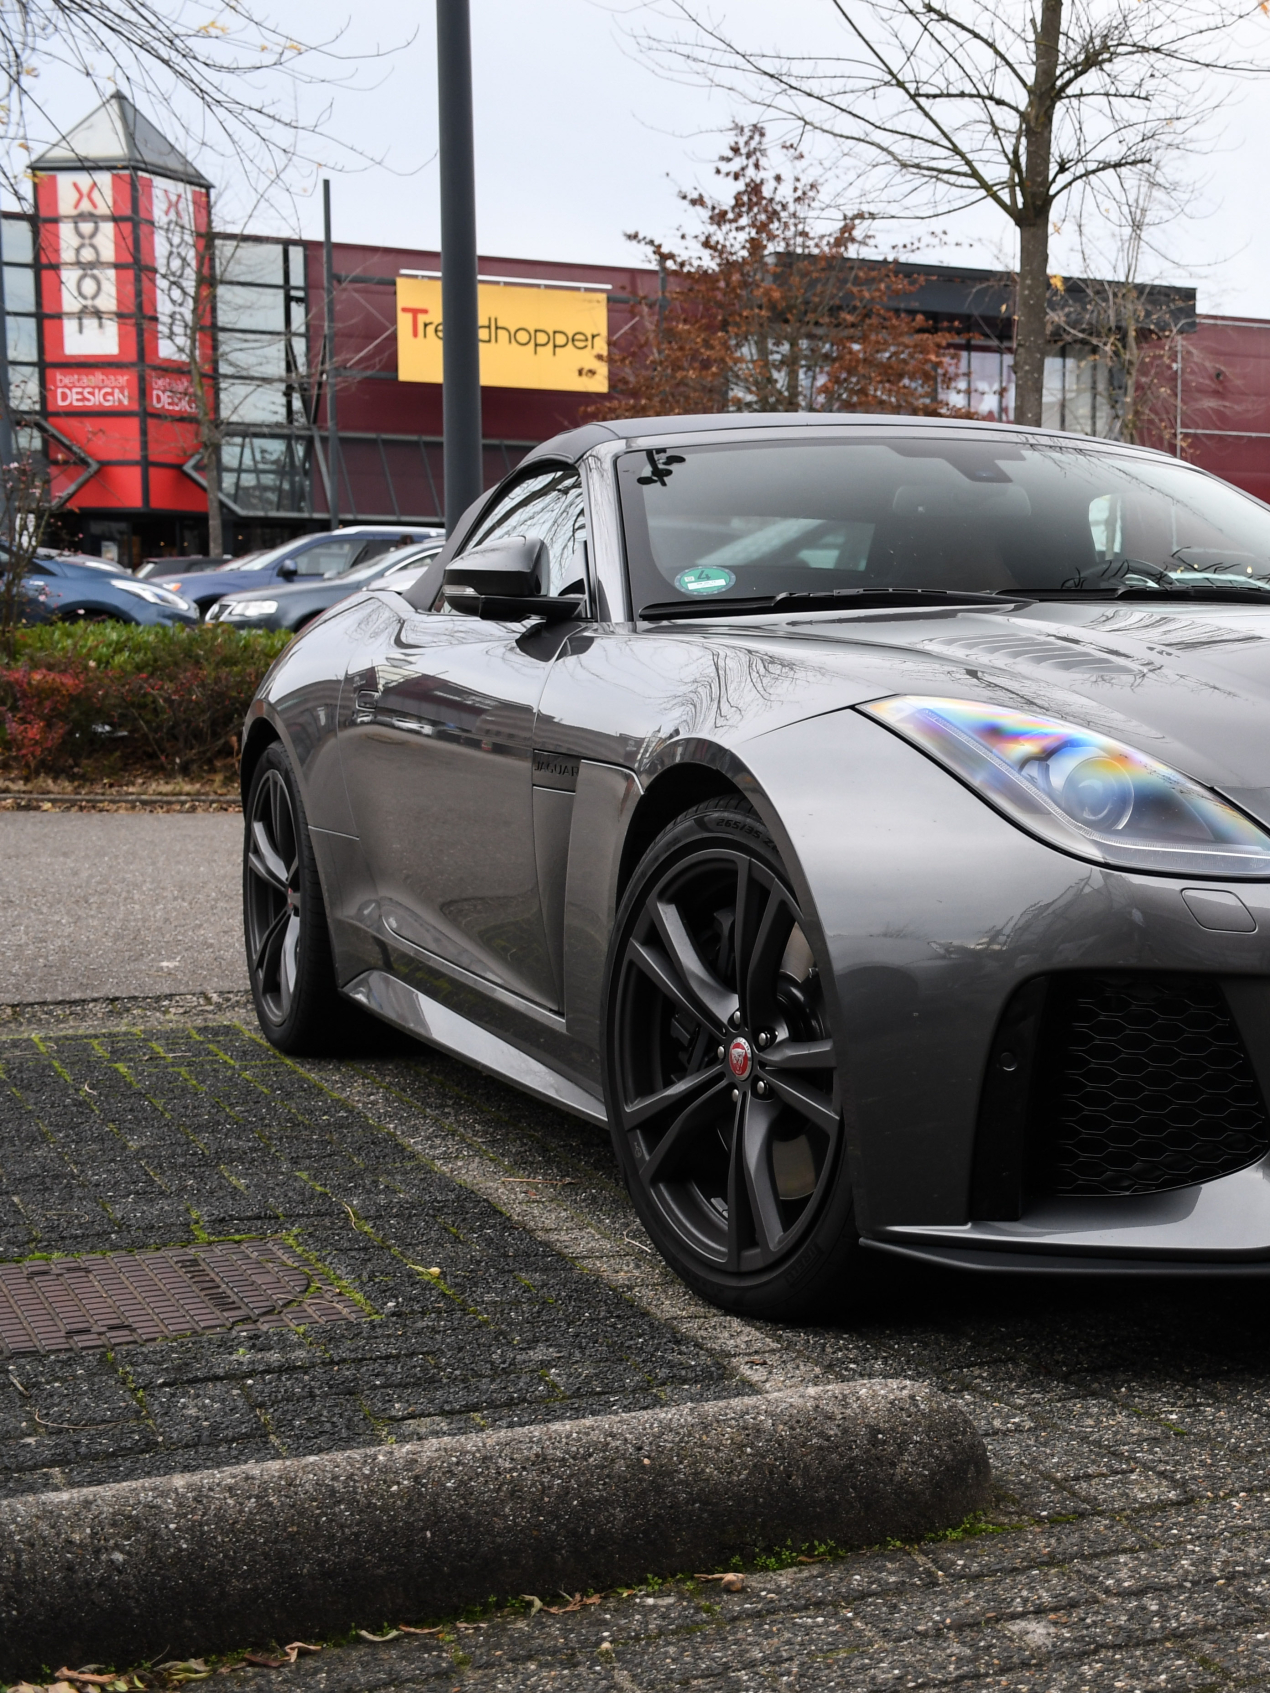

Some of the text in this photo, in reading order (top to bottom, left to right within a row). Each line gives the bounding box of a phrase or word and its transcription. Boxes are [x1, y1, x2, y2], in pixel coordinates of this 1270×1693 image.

[401, 307, 601, 357] Tredhopper
[57, 387, 129, 407] DESIGN
[697, 570, 711, 580] 4
[534, 761, 580, 777] JAGUAR
[716, 818, 762, 839] 265/35
